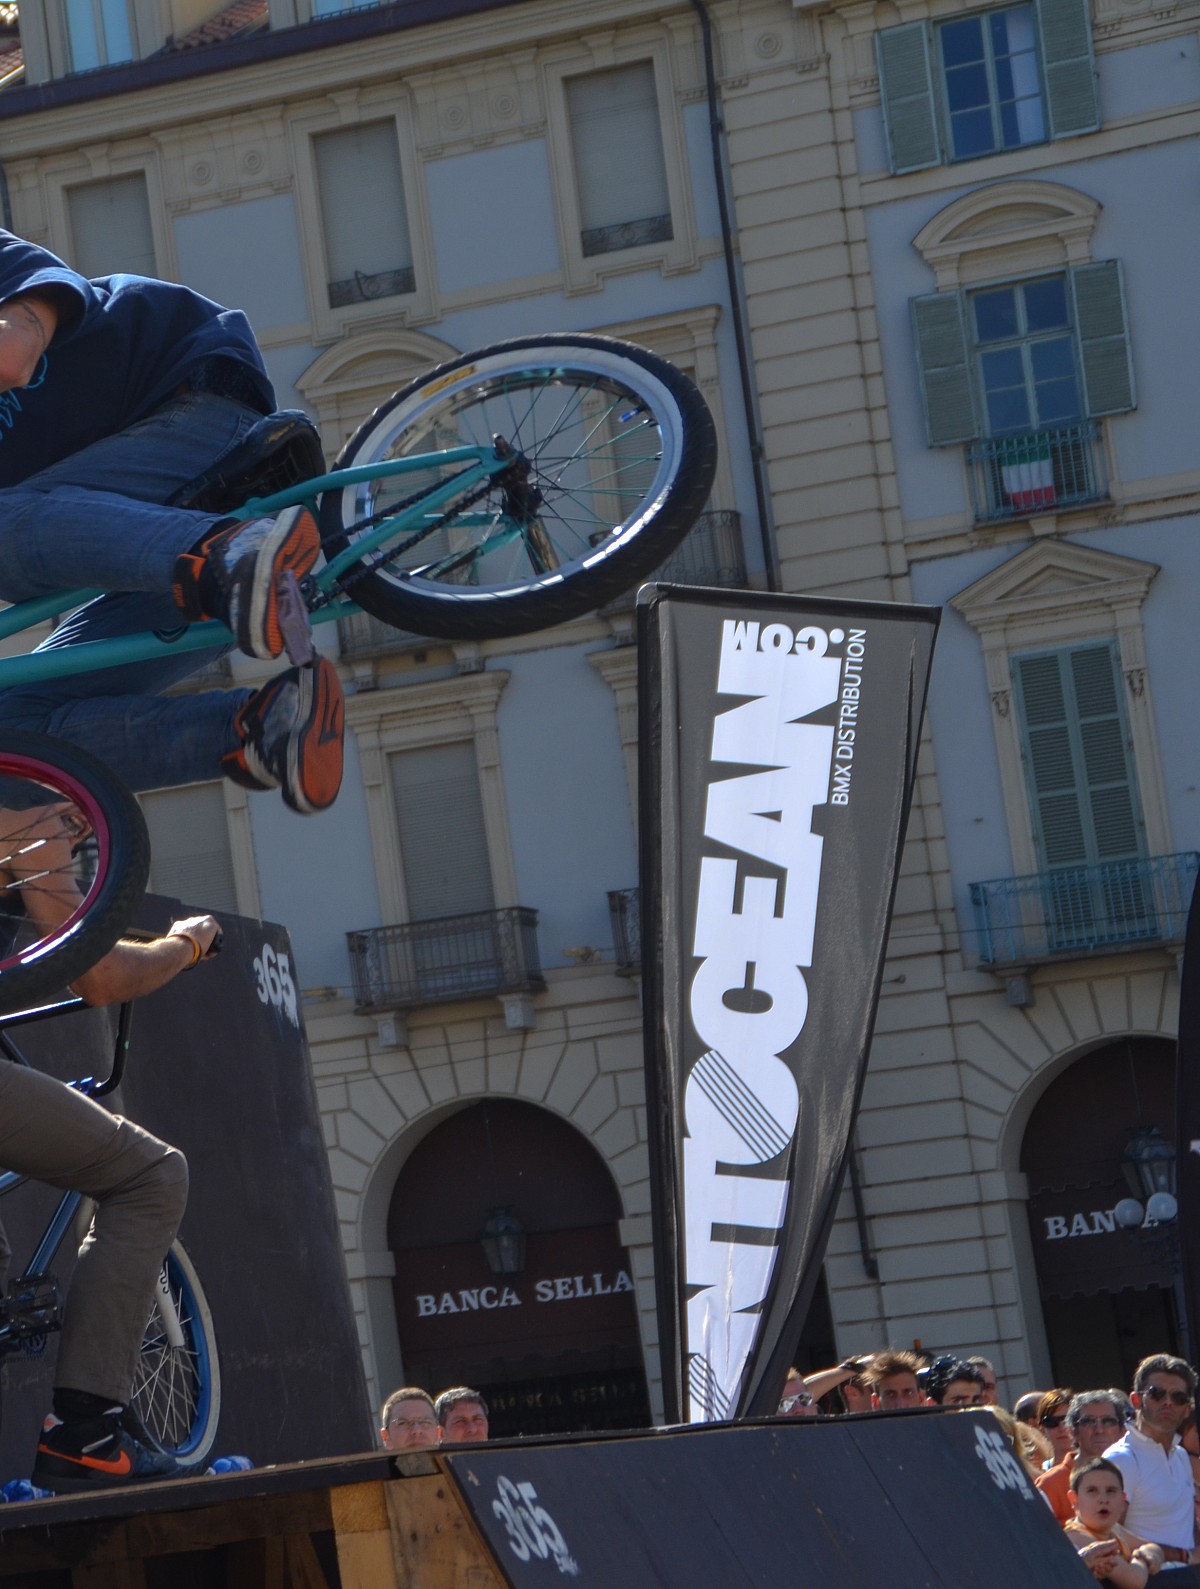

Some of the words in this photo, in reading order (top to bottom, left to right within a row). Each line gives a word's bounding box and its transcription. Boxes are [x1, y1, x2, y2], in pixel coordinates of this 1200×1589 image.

[723, 620, 844, 658] .COM
[836, 628, 867, 761] DISTRIBUTION
[831, 763, 854, 806] BMX
[253, 943, 297, 1014] 365
[417, 1287, 521, 1317] BANCA
[535, 1270, 635, 1303] SELLA
[492, 1475, 569, 1562] 365
